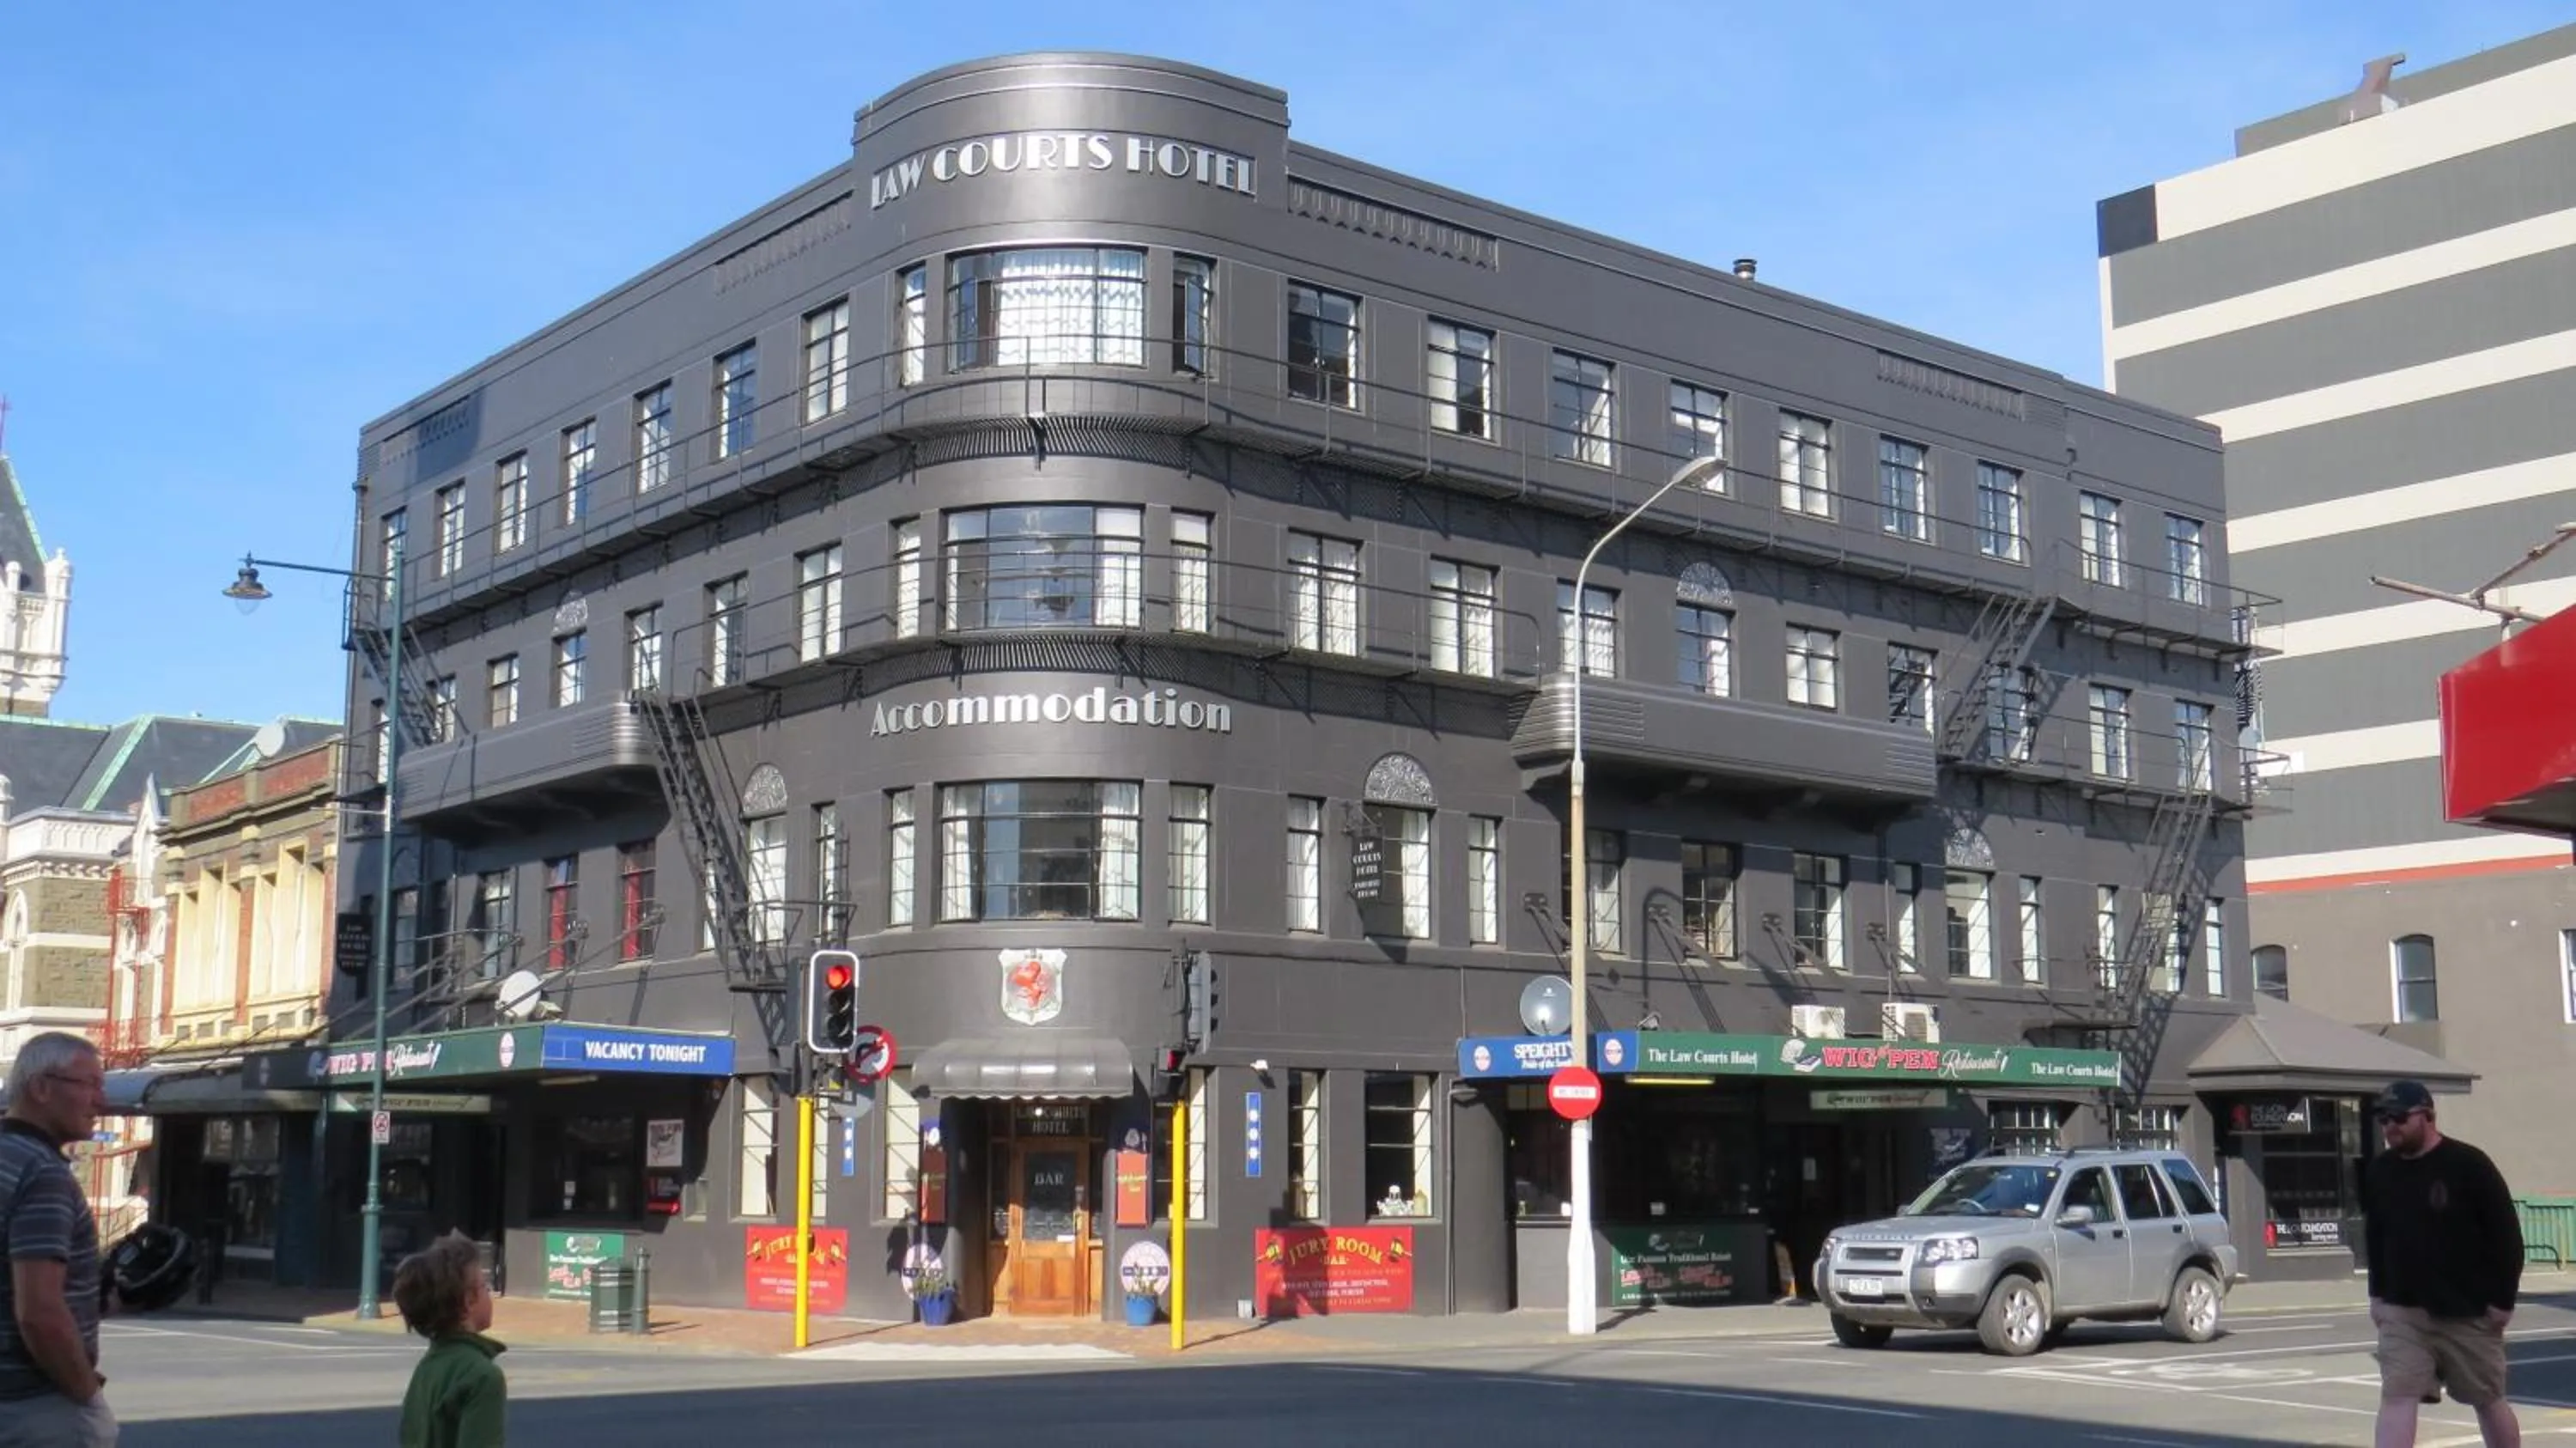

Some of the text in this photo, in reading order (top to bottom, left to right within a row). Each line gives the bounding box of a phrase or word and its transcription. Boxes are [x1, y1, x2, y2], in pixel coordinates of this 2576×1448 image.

[871, 132, 1258, 210] LAW COURTS HOTEL
[871, 686, 1232, 738] Accommodation
[586, 1041, 707, 1063] VACANCY TONIGHT
[1649, 1049, 1758, 1066] The Law Courts Hotel
[1822, 1045, 1878, 1068] WIG
[1888, 1049, 1940, 1070] PEN
[2031, 1062, 2046, 1075] The
[2047, 1063, 2065, 1075] Law
[2066, 1064, 2093, 1077] Courts
[1034, 1172, 1064, 1186] BAR
[1289, 1236, 1383, 1266] JURY ROOM
